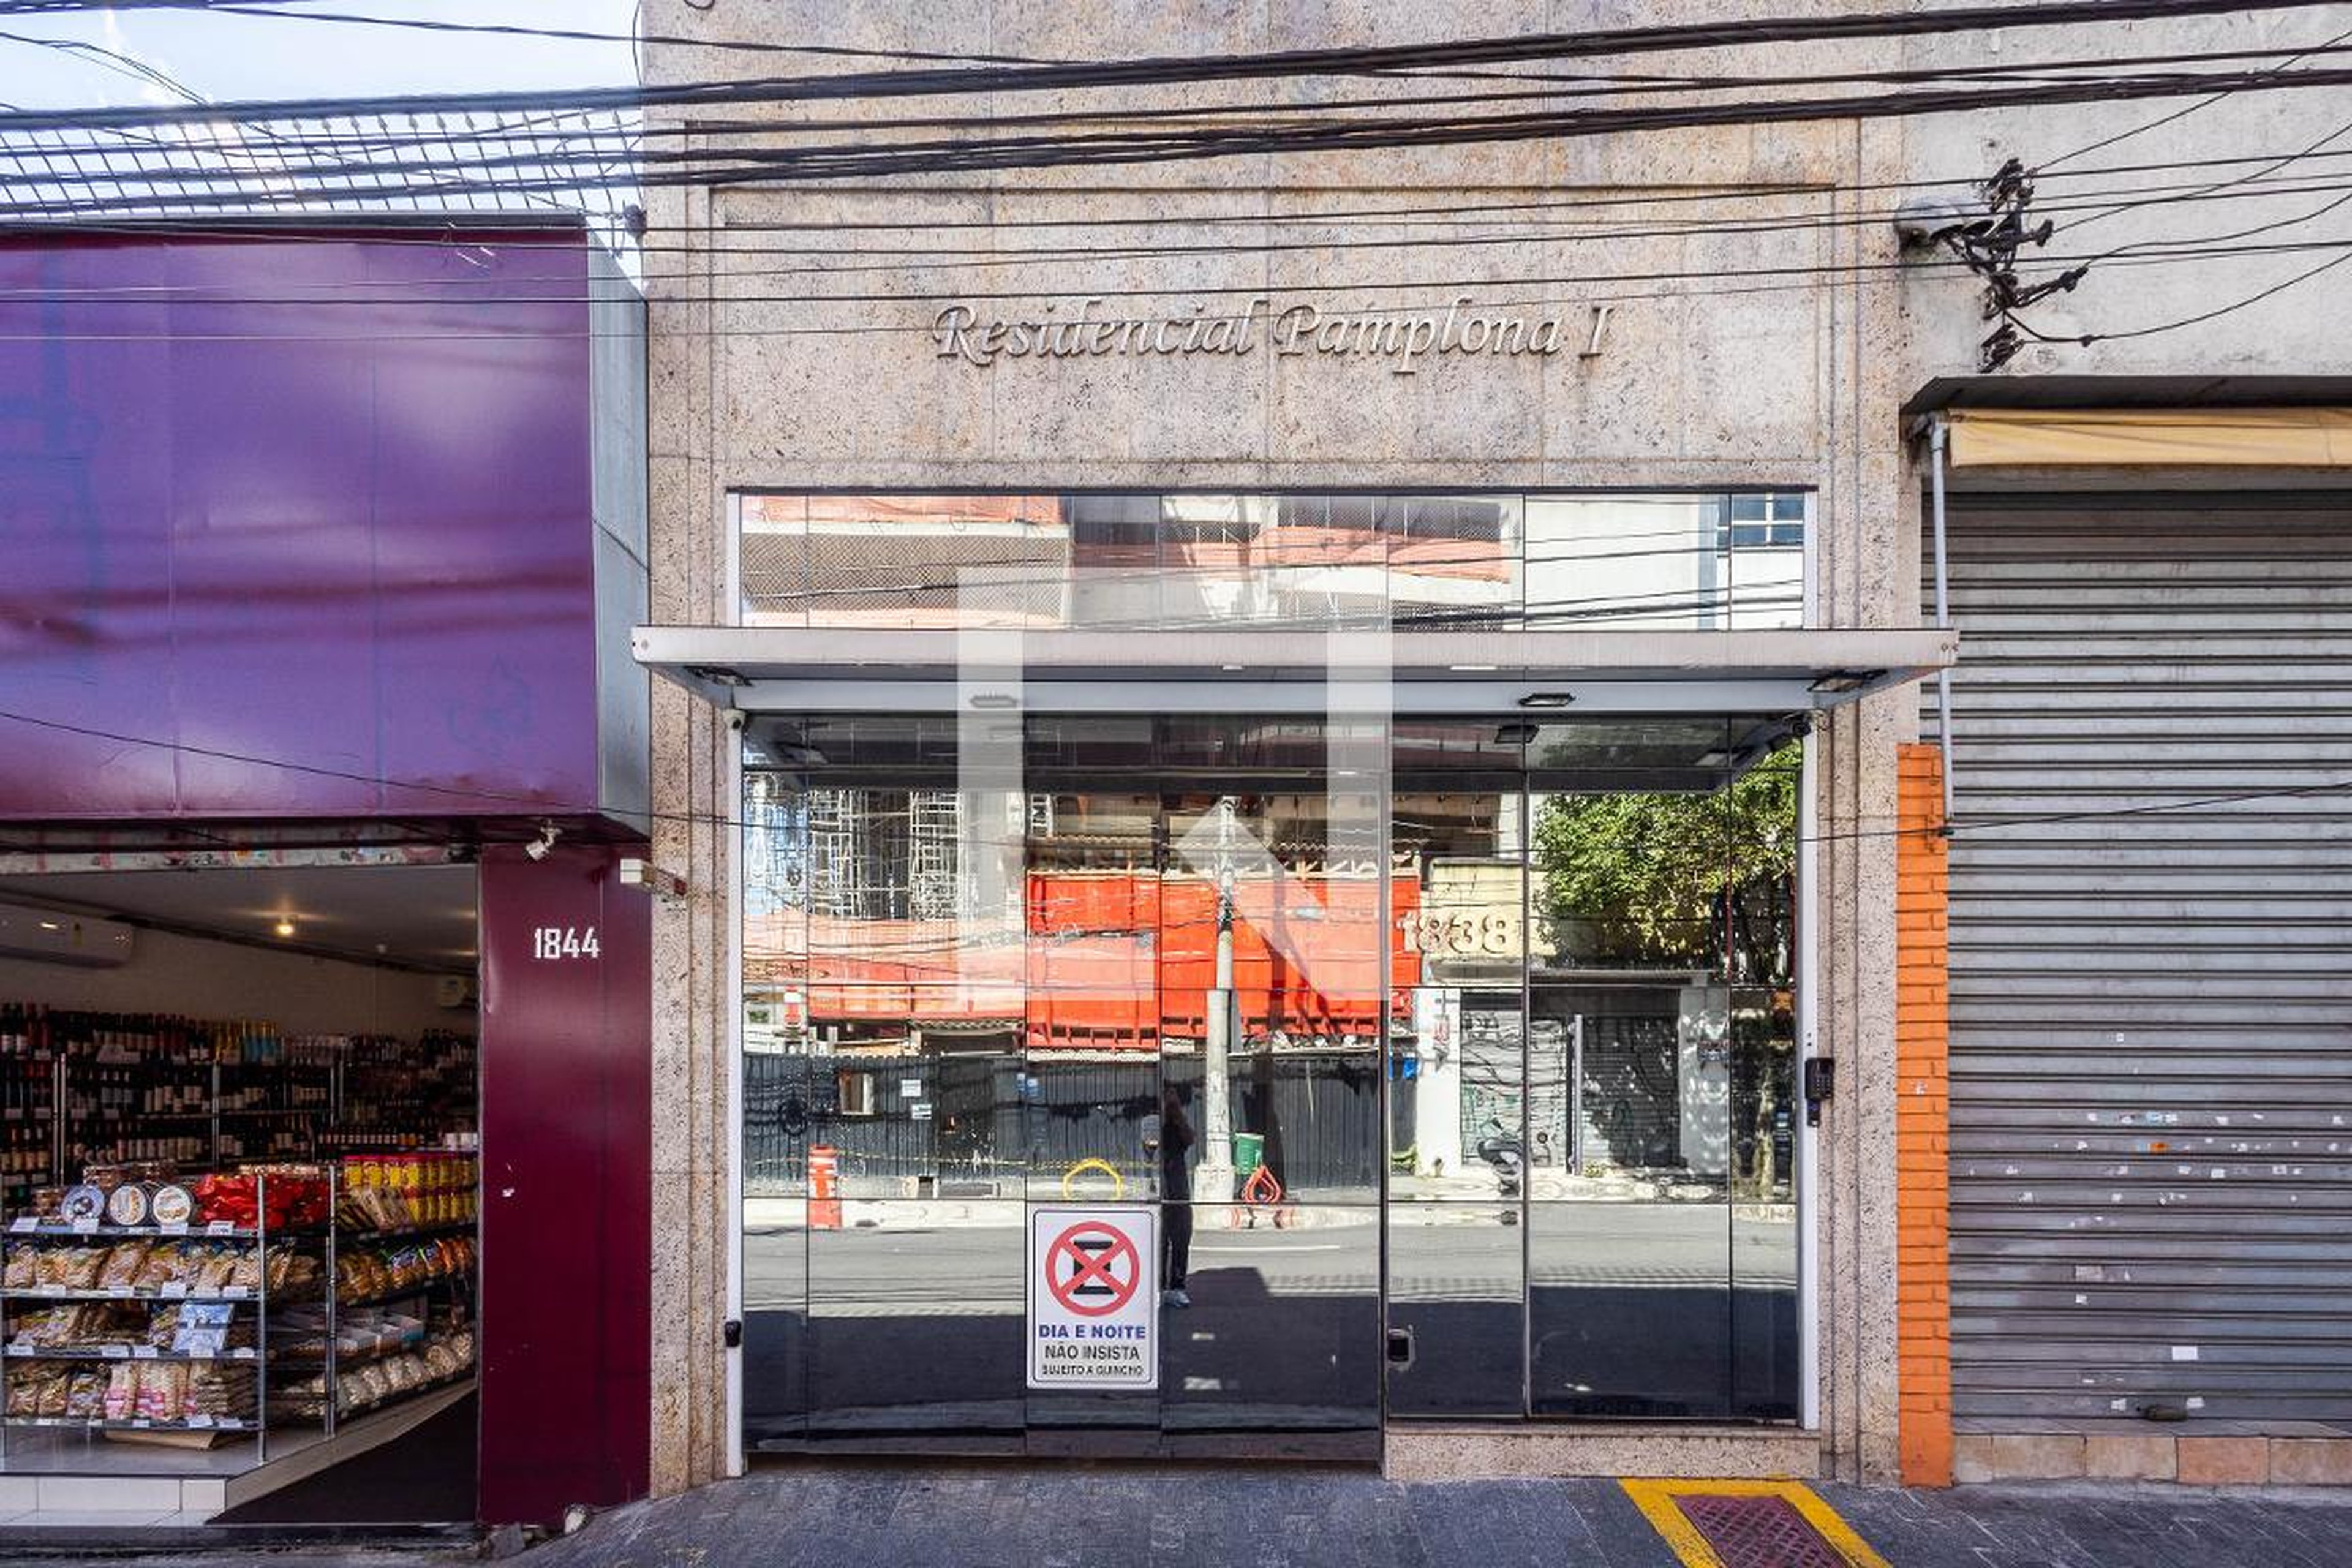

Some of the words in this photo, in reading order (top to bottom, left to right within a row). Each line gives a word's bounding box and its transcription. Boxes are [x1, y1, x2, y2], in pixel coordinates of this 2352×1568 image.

[932, 299, 1270, 368] Residencial
[1273, 296, 1561, 375] Pamplona
[1579, 307, 1614, 358] I
[534, 927, 601, 959] 1844
[1039, 1324, 1069, 1338] DIA
[1075, 1324, 1085, 1338] E
[1091, 1325, 1147, 1340] NOITE
[1044, 1341, 1079, 1359] NÃO
[1082, 1345, 1140, 1360] INSISTA
